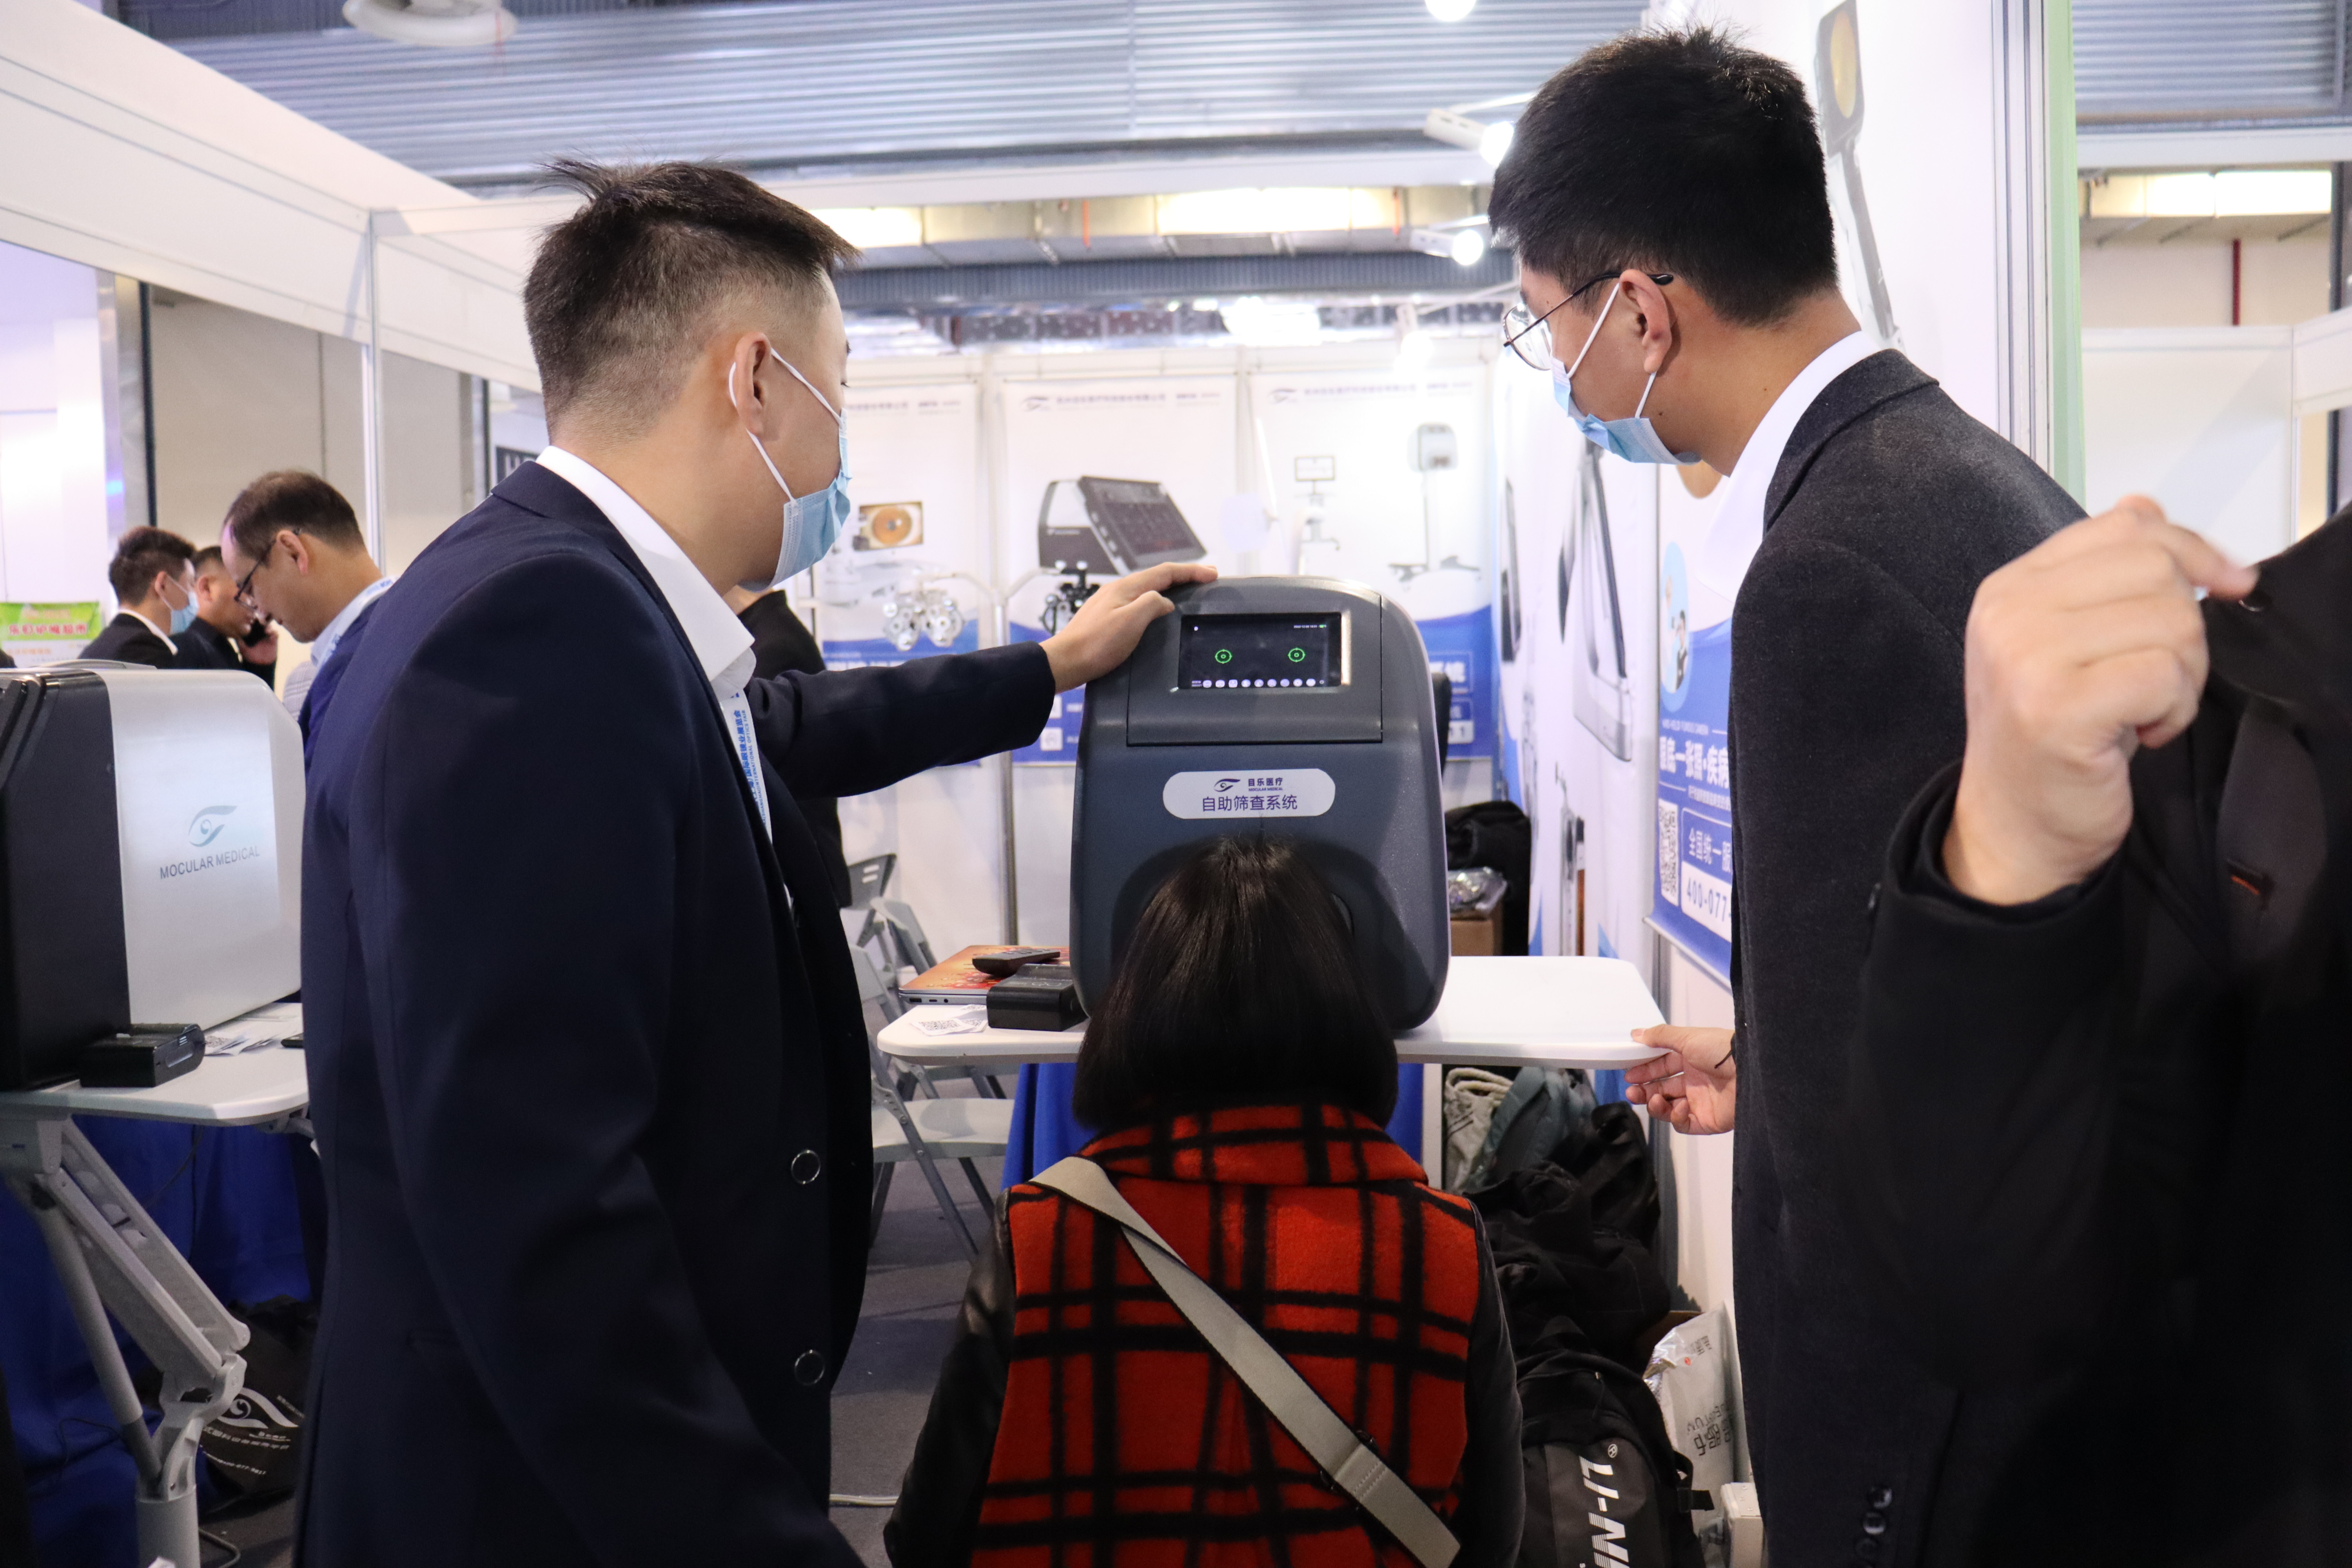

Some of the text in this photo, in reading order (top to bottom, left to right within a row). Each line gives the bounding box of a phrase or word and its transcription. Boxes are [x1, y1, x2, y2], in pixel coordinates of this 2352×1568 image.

[748, 745, 766, 827] A(SHANGHAI)INTERNATIONAL
[1248, 777, 1283, 786] 目乐医疗
[1202, 794, 1298, 812] 自助筛查系统
[160, 846, 260, 879] MOCULAR MEDICAL
